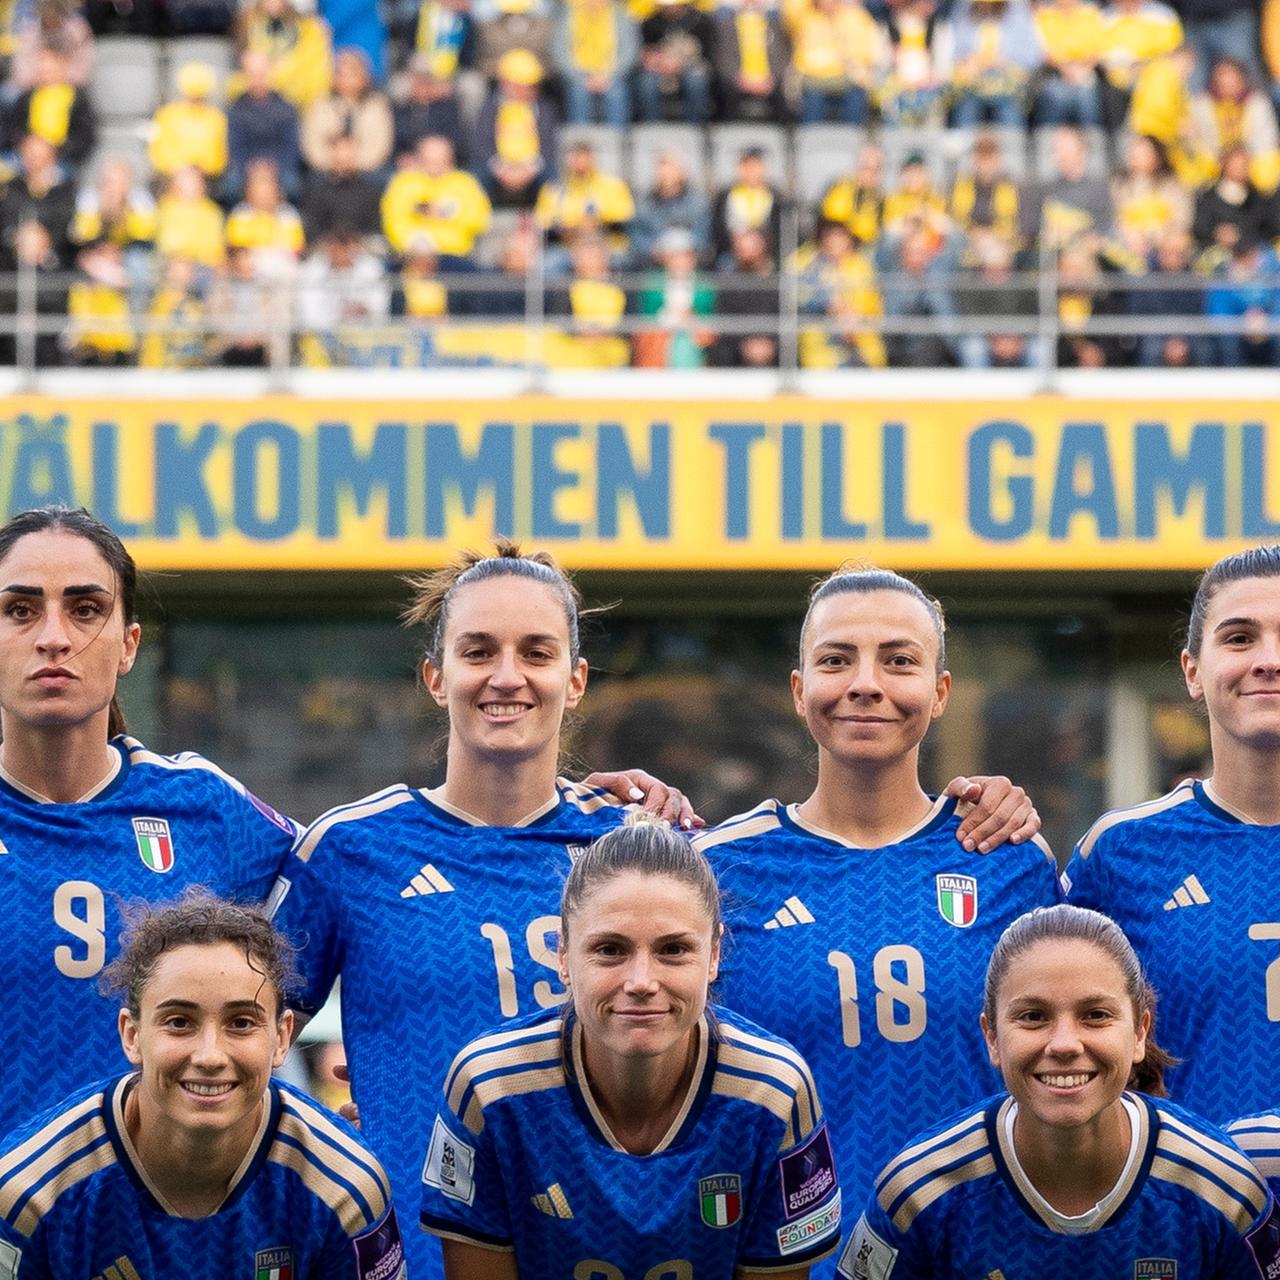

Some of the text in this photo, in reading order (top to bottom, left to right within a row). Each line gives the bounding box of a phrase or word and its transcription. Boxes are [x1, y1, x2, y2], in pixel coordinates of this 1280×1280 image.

[709, 423, 929, 540] TILL
[134, 821, 167, 834] ITALIA
[940, 877, 974, 891] ITALIA
[53, 880, 106, 979] 9
[827, 943, 927, 1048] 18
[701, 1177, 738, 1191] ITALIA
[257, 1250, 292, 1266] ITALIA
[1137, 1262, 1173, 1275] ITALIA
